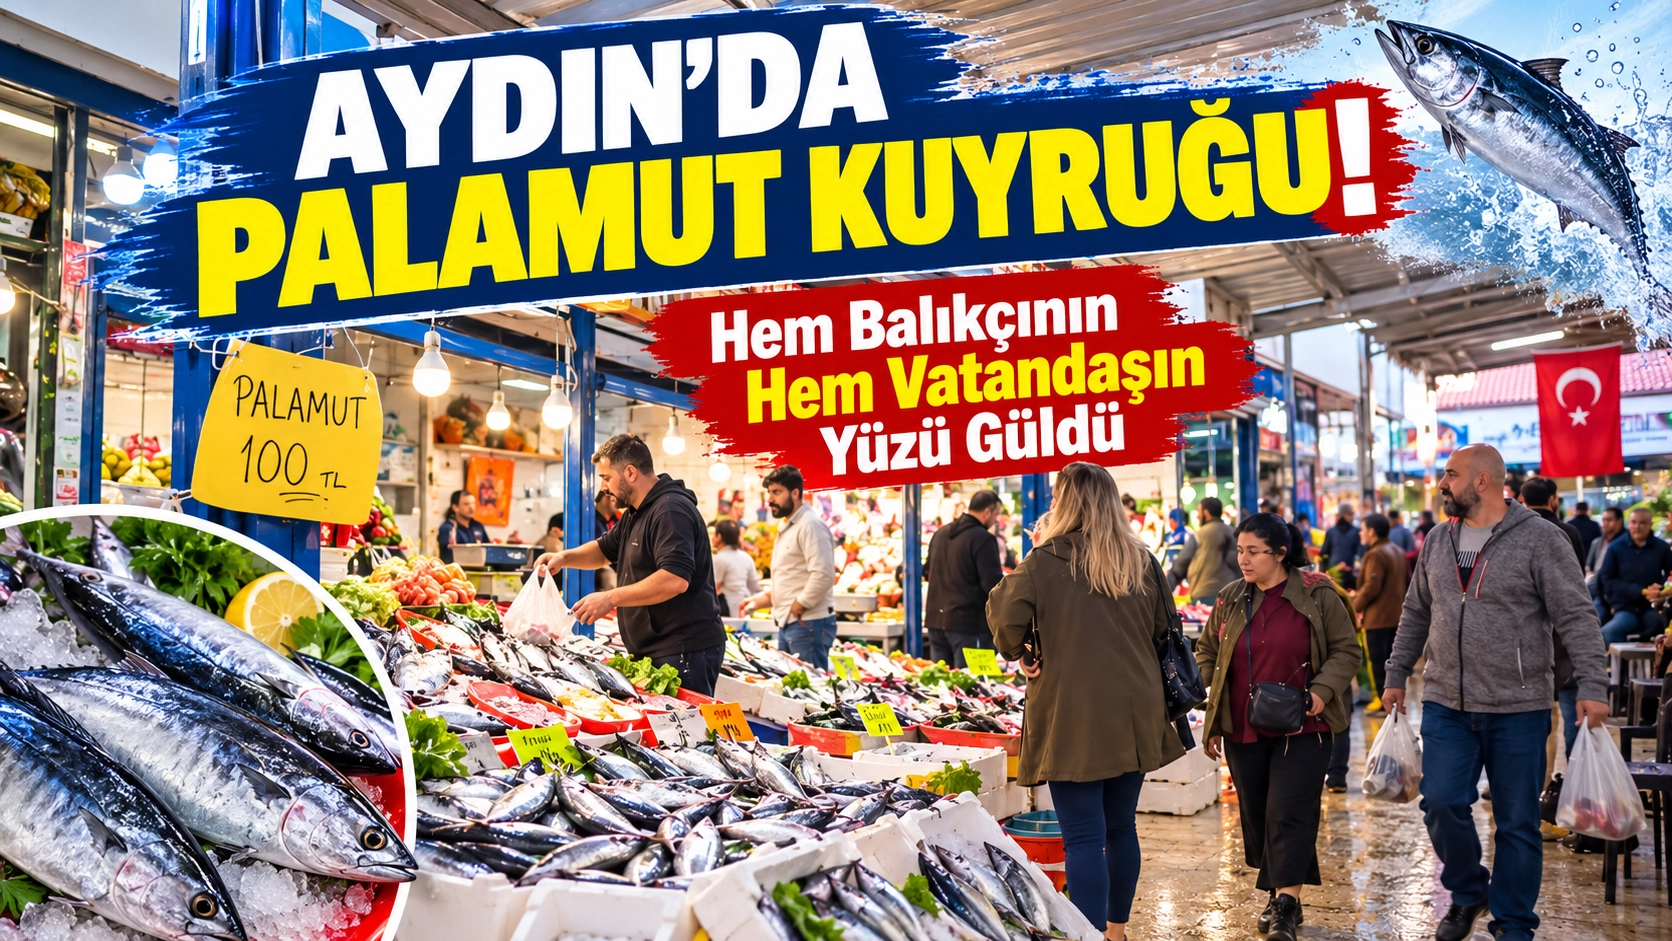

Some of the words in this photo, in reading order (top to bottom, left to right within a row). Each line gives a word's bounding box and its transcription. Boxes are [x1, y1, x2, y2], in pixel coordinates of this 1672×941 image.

[233, 374, 367, 429] PALAMUT
[241, 434, 308, 486] 100
[320, 471, 347, 488] TL
